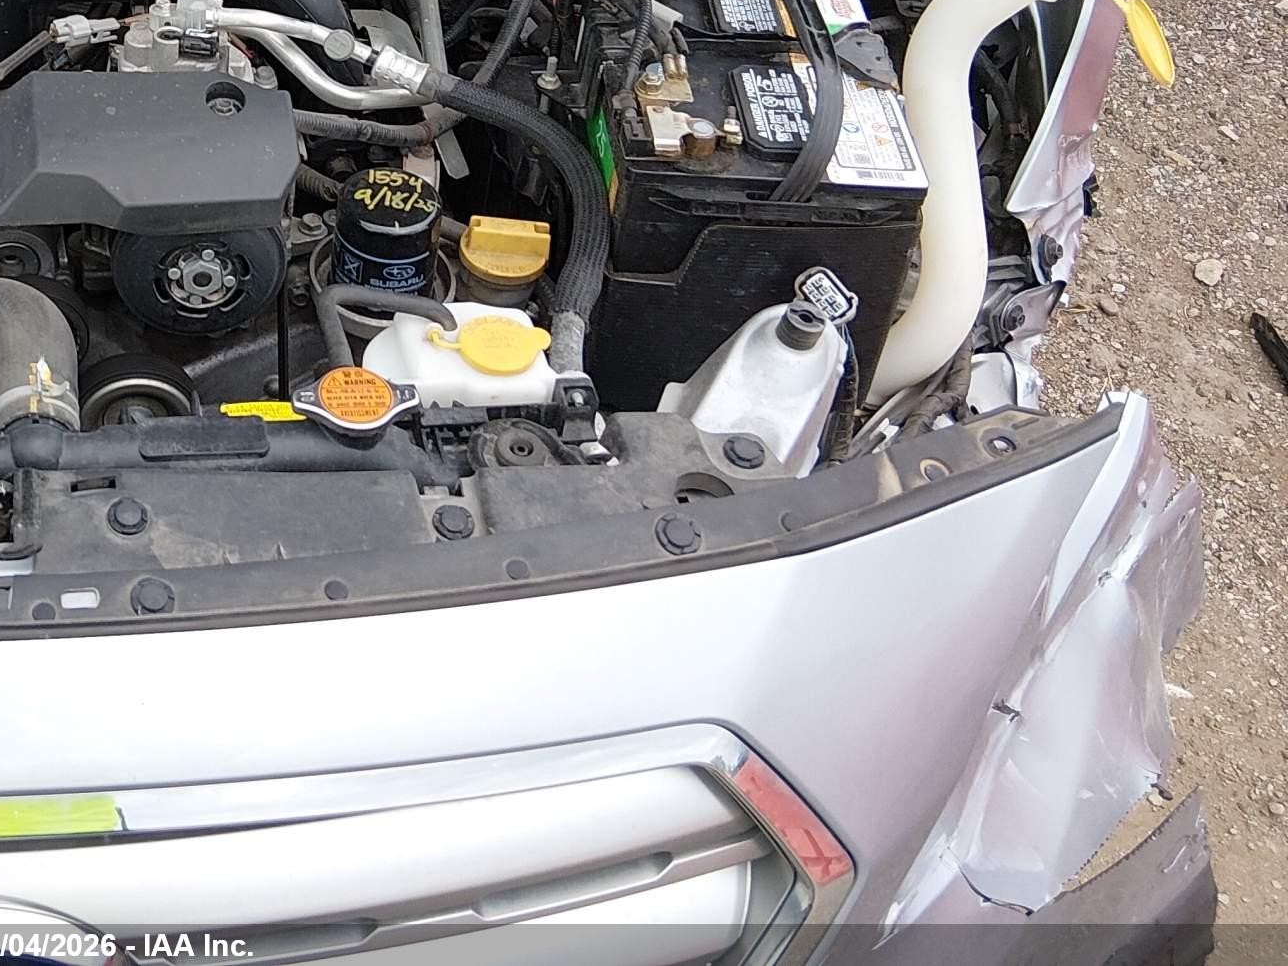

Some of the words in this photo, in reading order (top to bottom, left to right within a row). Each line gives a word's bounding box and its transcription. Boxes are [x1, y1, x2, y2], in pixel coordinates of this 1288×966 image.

[368, 169, 423, 193] 1554
[369, 273, 425, 288] SUBARU
[343, 378, 377, 386] WARNING
